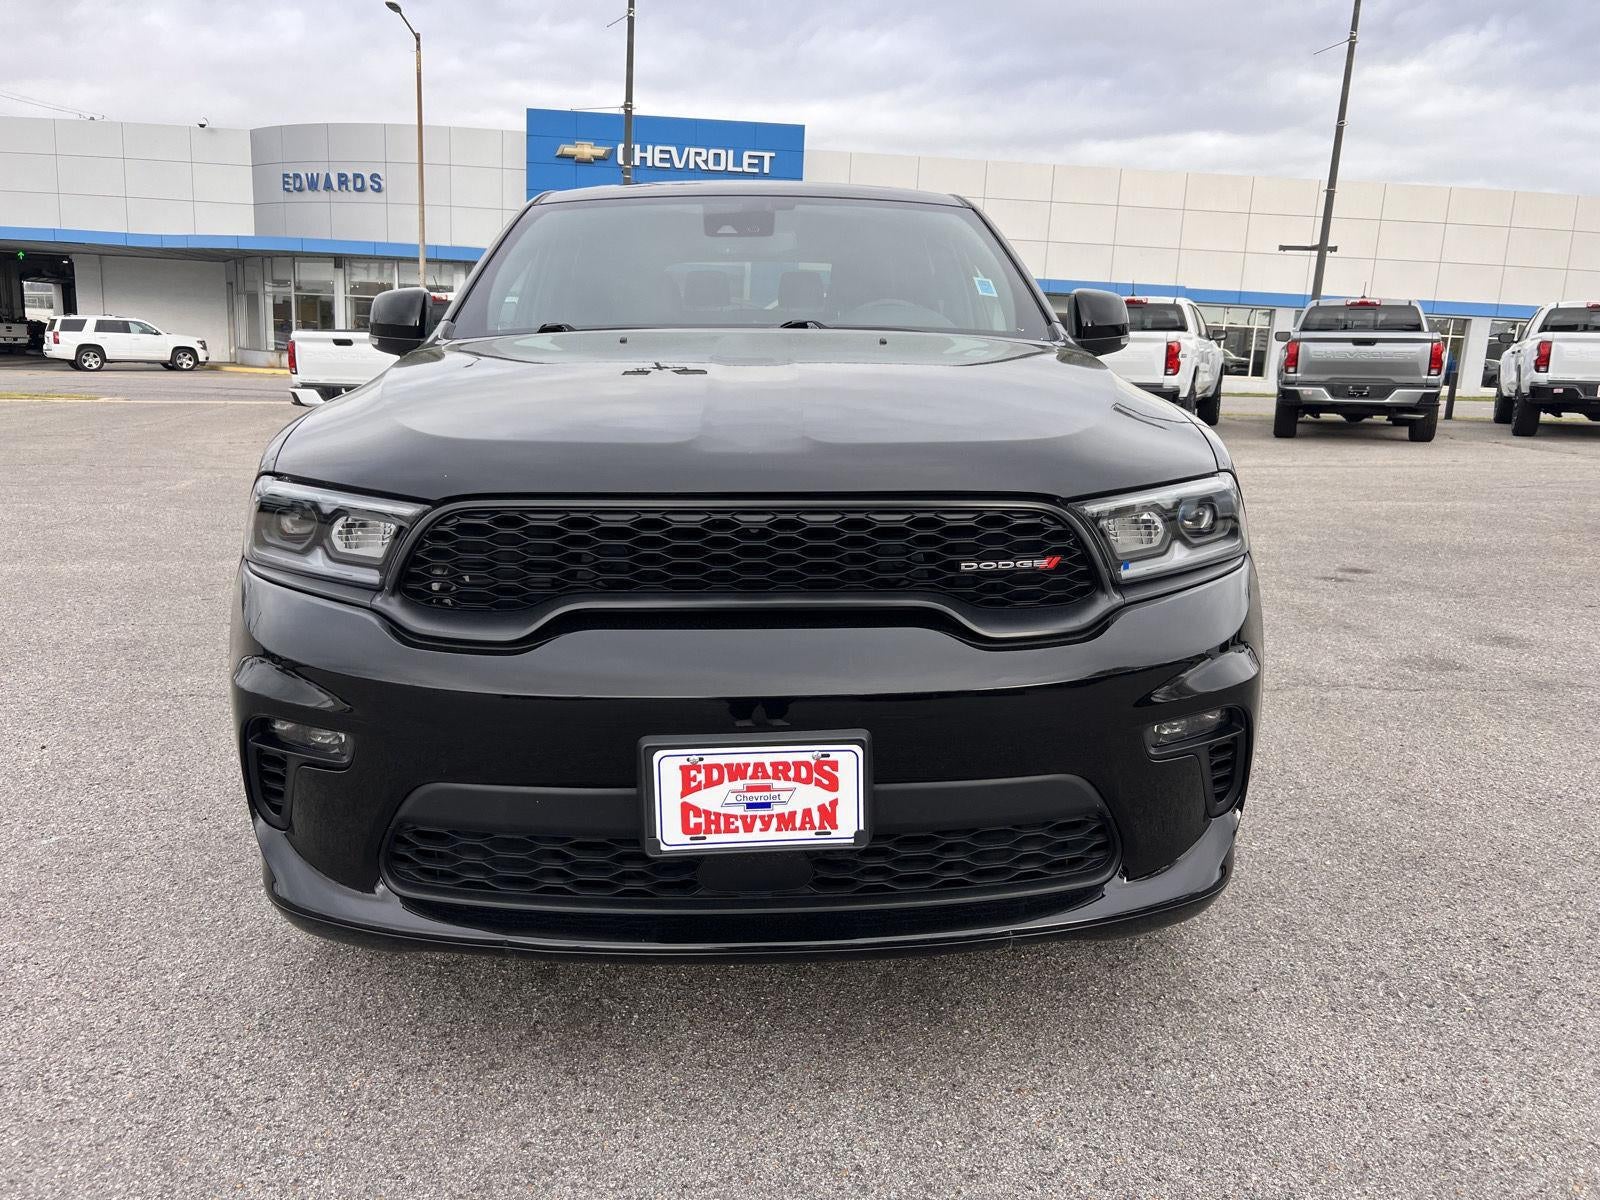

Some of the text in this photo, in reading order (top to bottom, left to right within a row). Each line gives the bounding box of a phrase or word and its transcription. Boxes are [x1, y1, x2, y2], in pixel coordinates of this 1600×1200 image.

[617, 143, 776, 174] CHEVROLET
[282, 172, 384, 193] EDWARDS
[960, 560, 1049, 571] DODGE
[679, 760, 839, 799] EDWARDS
[735, 793, 782, 802] Chevrolet
[680, 798, 839, 835] CHEVYMAN
